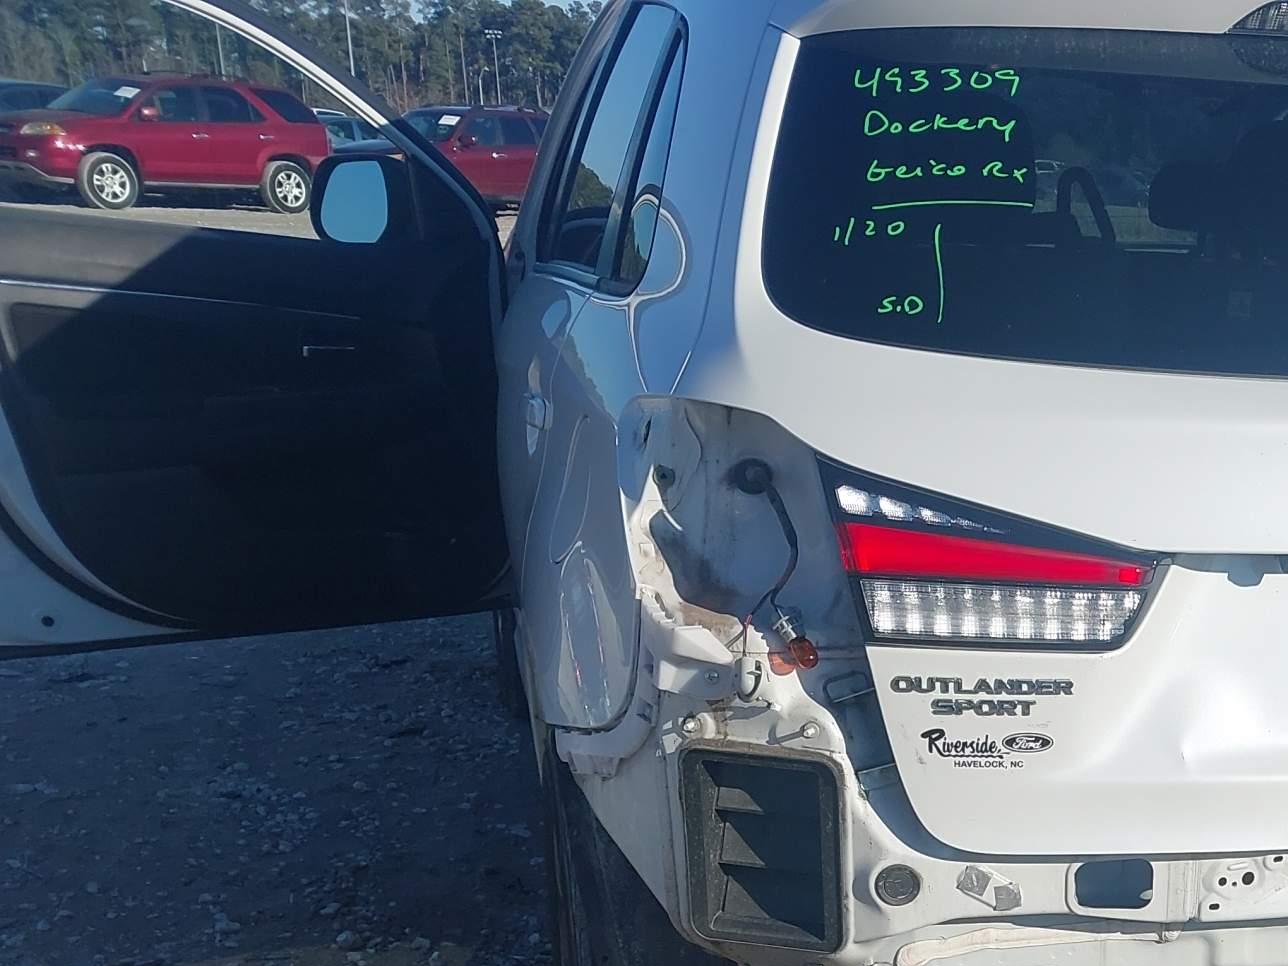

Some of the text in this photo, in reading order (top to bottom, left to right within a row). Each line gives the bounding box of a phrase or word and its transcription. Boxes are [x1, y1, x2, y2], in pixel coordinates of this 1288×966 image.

[863, 110, 1016, 142] Dockery
[889, 675, 1074, 696] OUTLANDER
[931, 698, 1037, 717] SPORT
[953, 760, 1025, 769] HAVELOCK, NC
